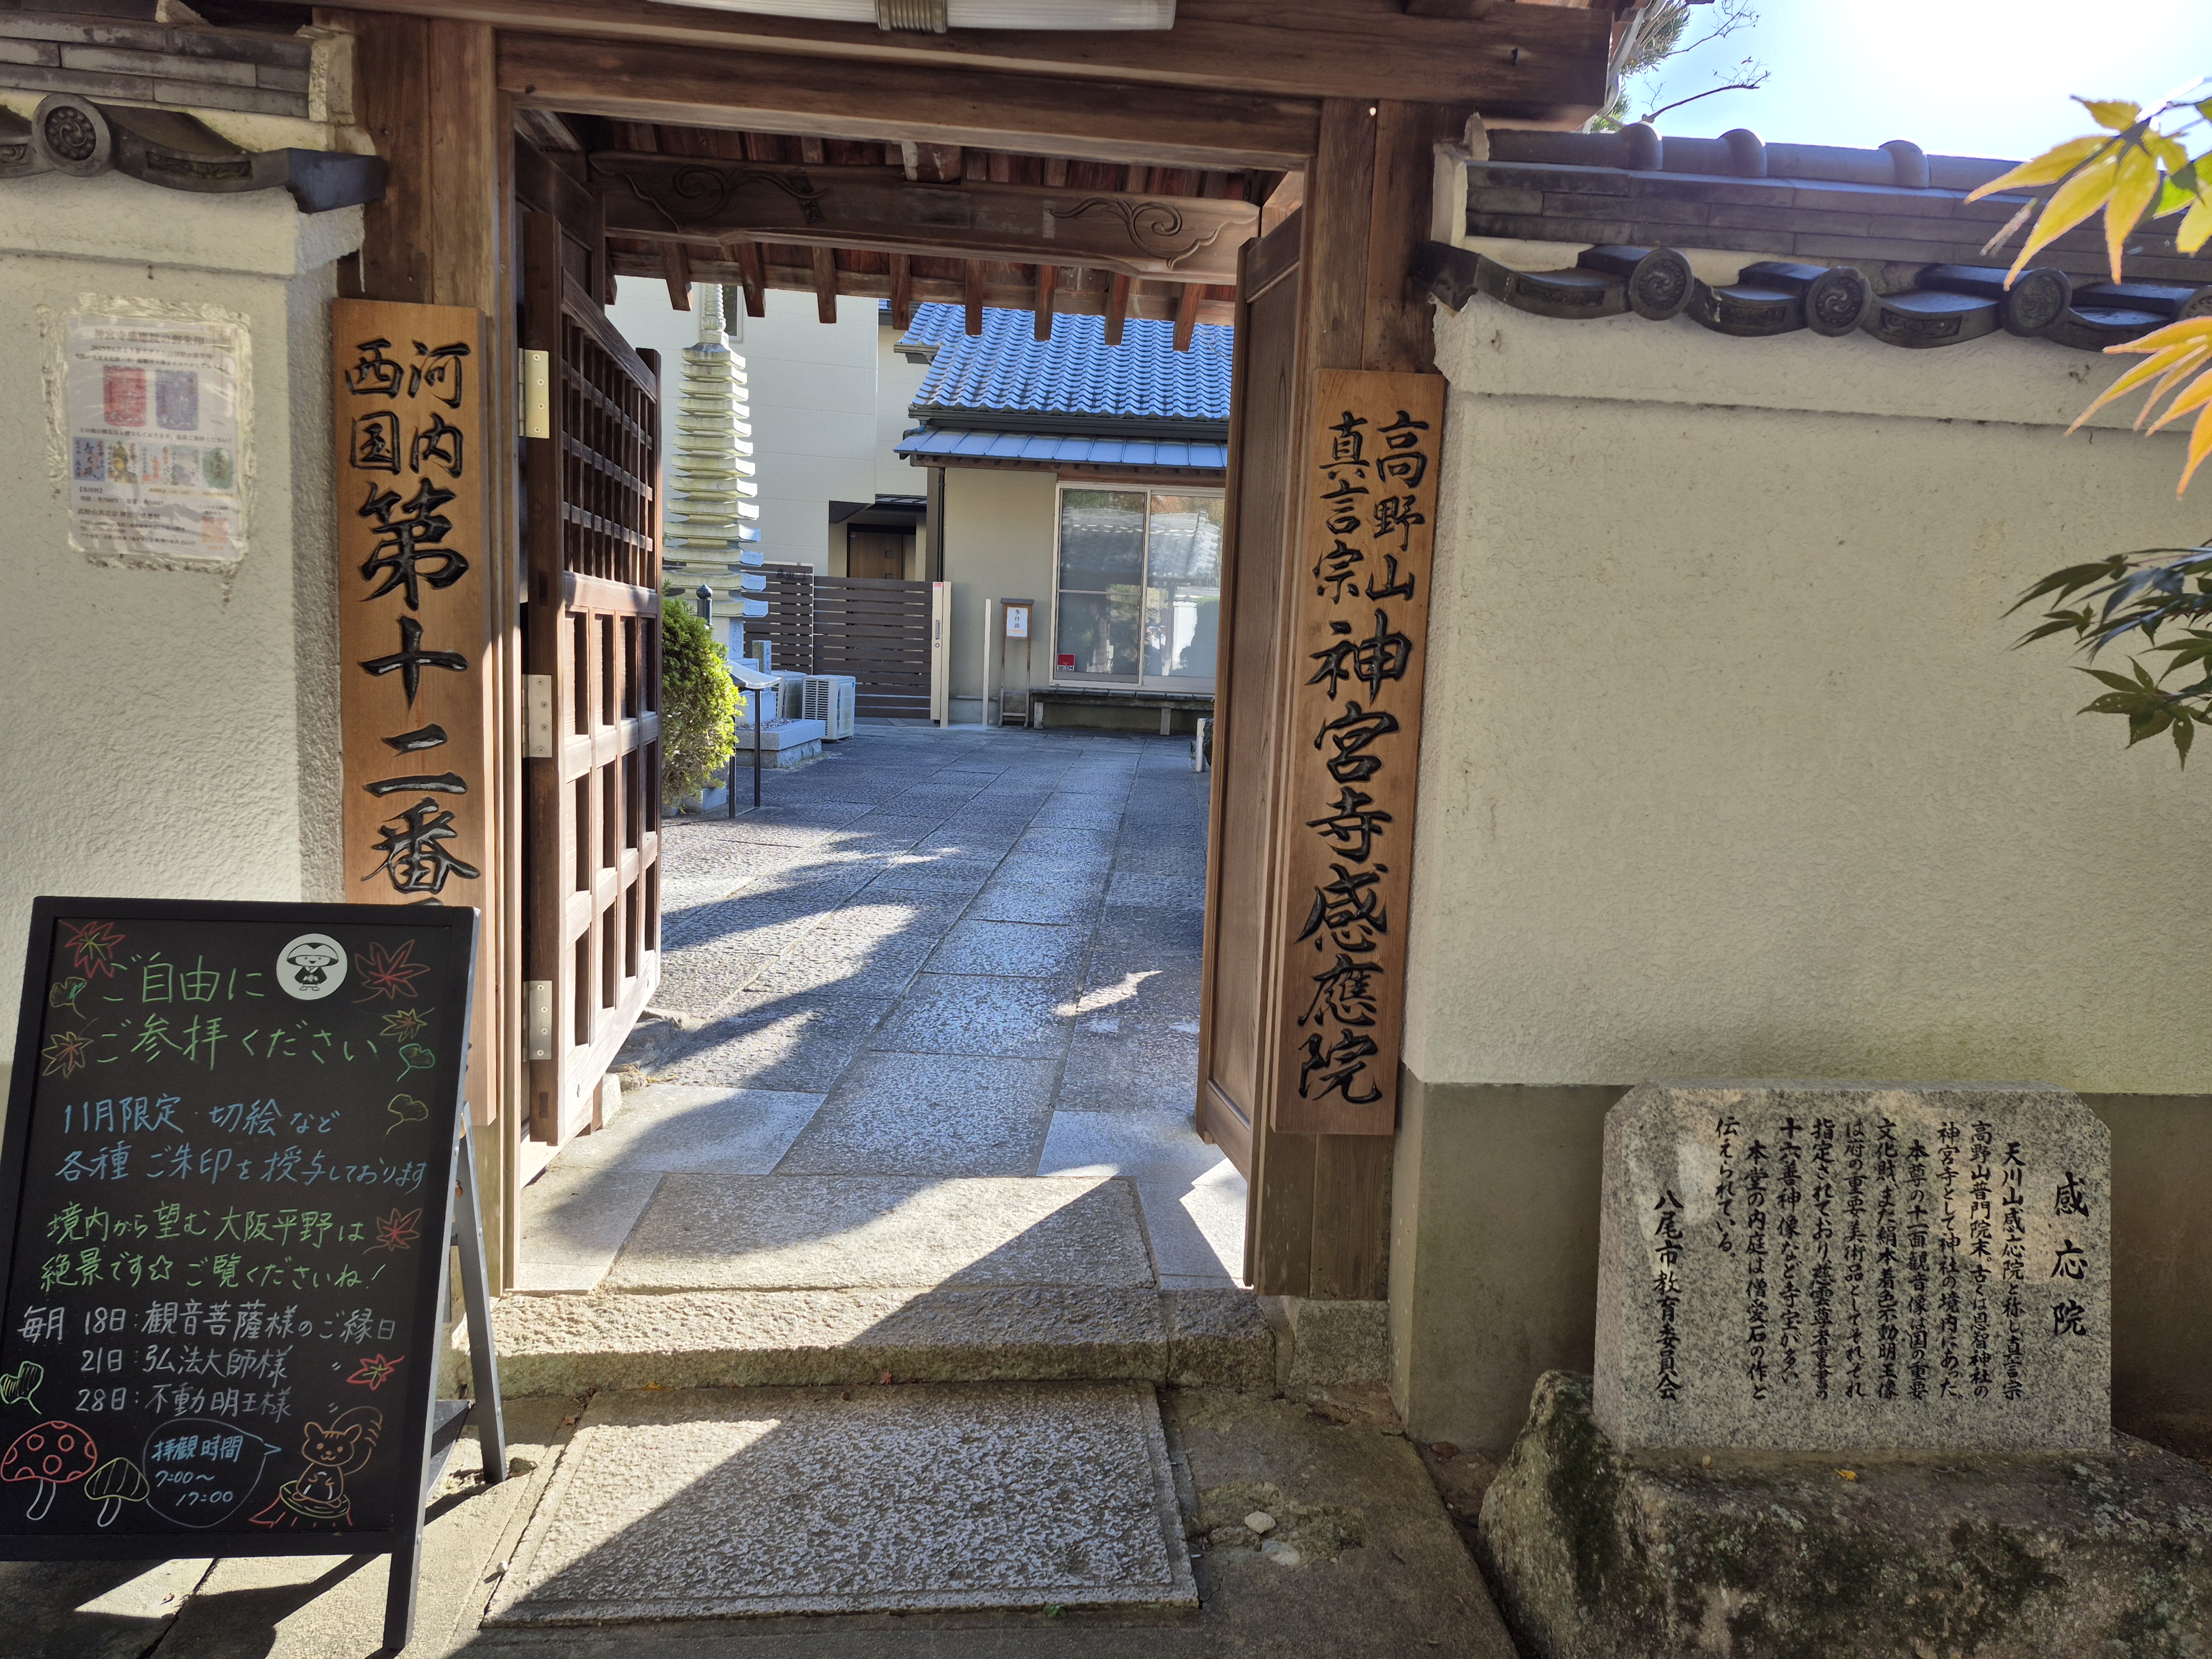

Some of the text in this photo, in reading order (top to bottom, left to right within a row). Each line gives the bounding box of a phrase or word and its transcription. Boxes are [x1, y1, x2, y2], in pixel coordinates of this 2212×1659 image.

[345, 337, 404, 476] 西国
[408, 339, 471, 478] 河内
[1313, 410, 1370, 605] 真言宗
[1365, 409, 1430, 601] 高野山
[96, 1012, 379, 1072] ご参拝ください
[103, 951, 265, 1004] ご自由に
[46, 1199, 365, 1249] 境内から望む大阪平野は
[1715, 1115, 1741, 1258] 伝えられている。
[17, 1305, 66, 1344] 毎月
[1653, 1189, 1684, 1401] 八尾市教育委員会
[151, 1434, 244, 1463] 拝観時間
